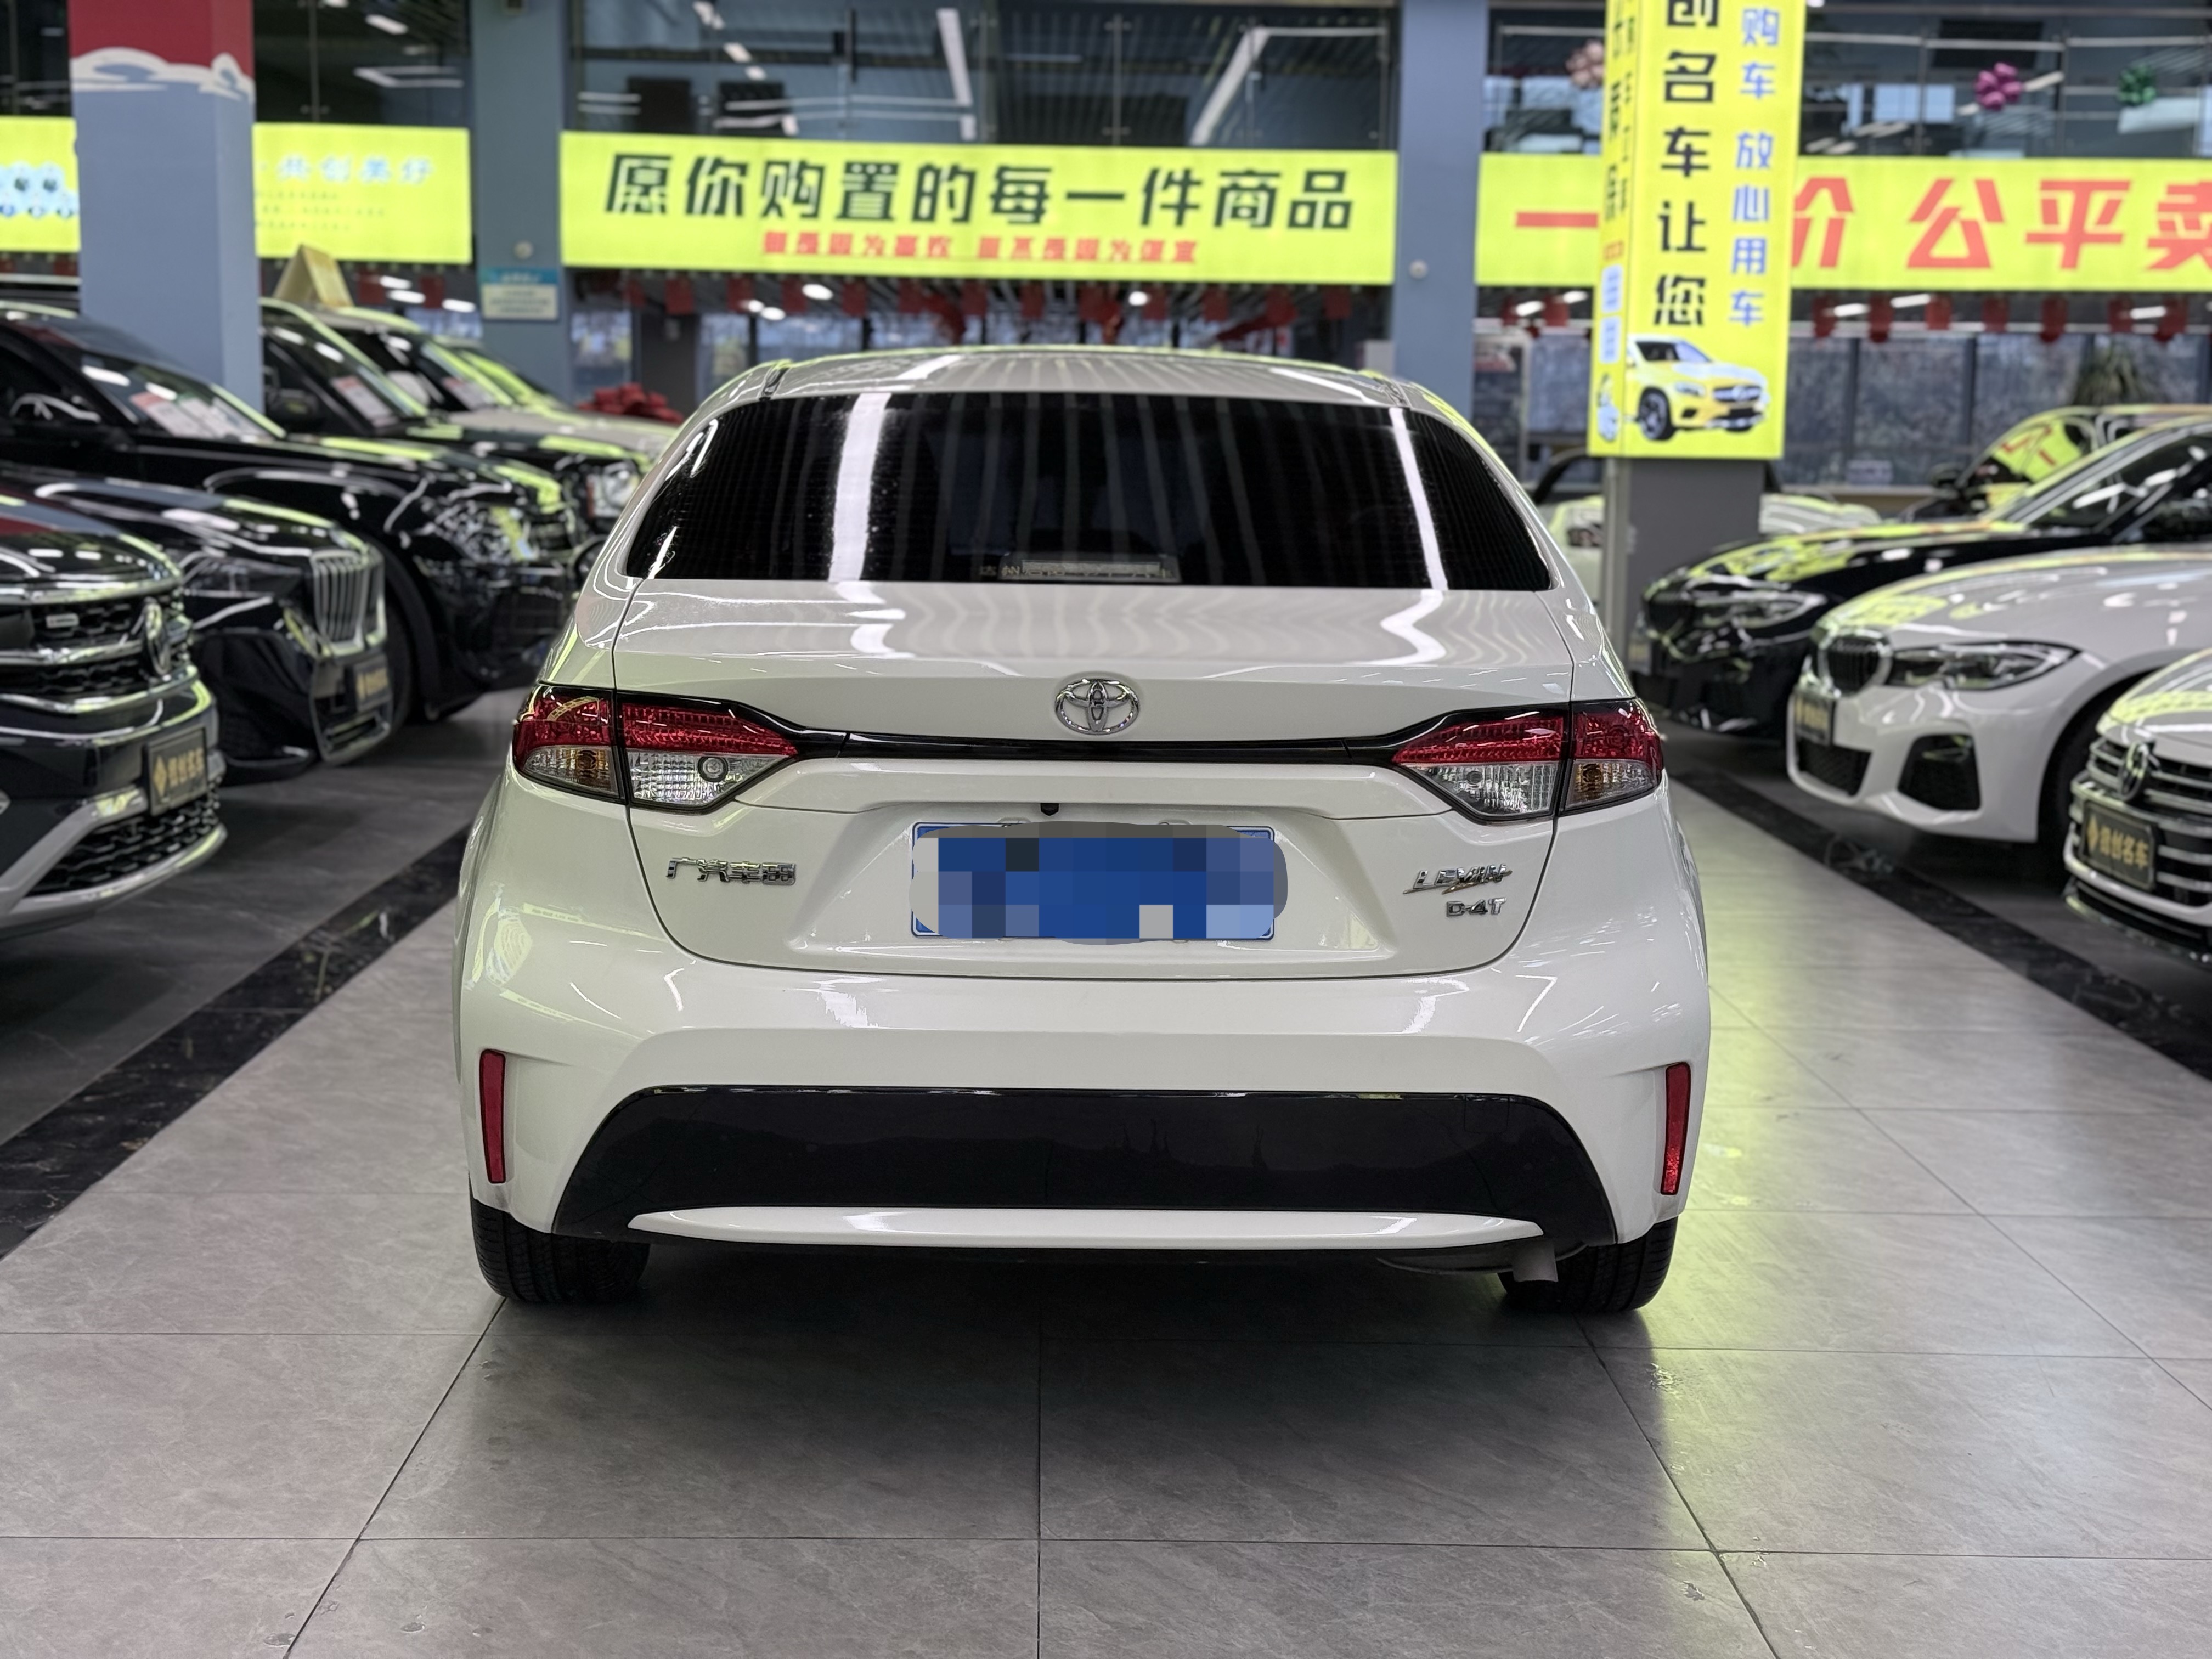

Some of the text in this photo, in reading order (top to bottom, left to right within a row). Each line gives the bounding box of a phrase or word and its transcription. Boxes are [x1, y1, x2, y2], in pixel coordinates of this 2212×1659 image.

[605, 153, 1353, 230] 愿你购置的每一件商品
[1729, 7, 1780, 327] 购车 放心用车
[666, 857, 797, 886] 广汽丰田
[1412, 863, 1508, 890] LEVIN
